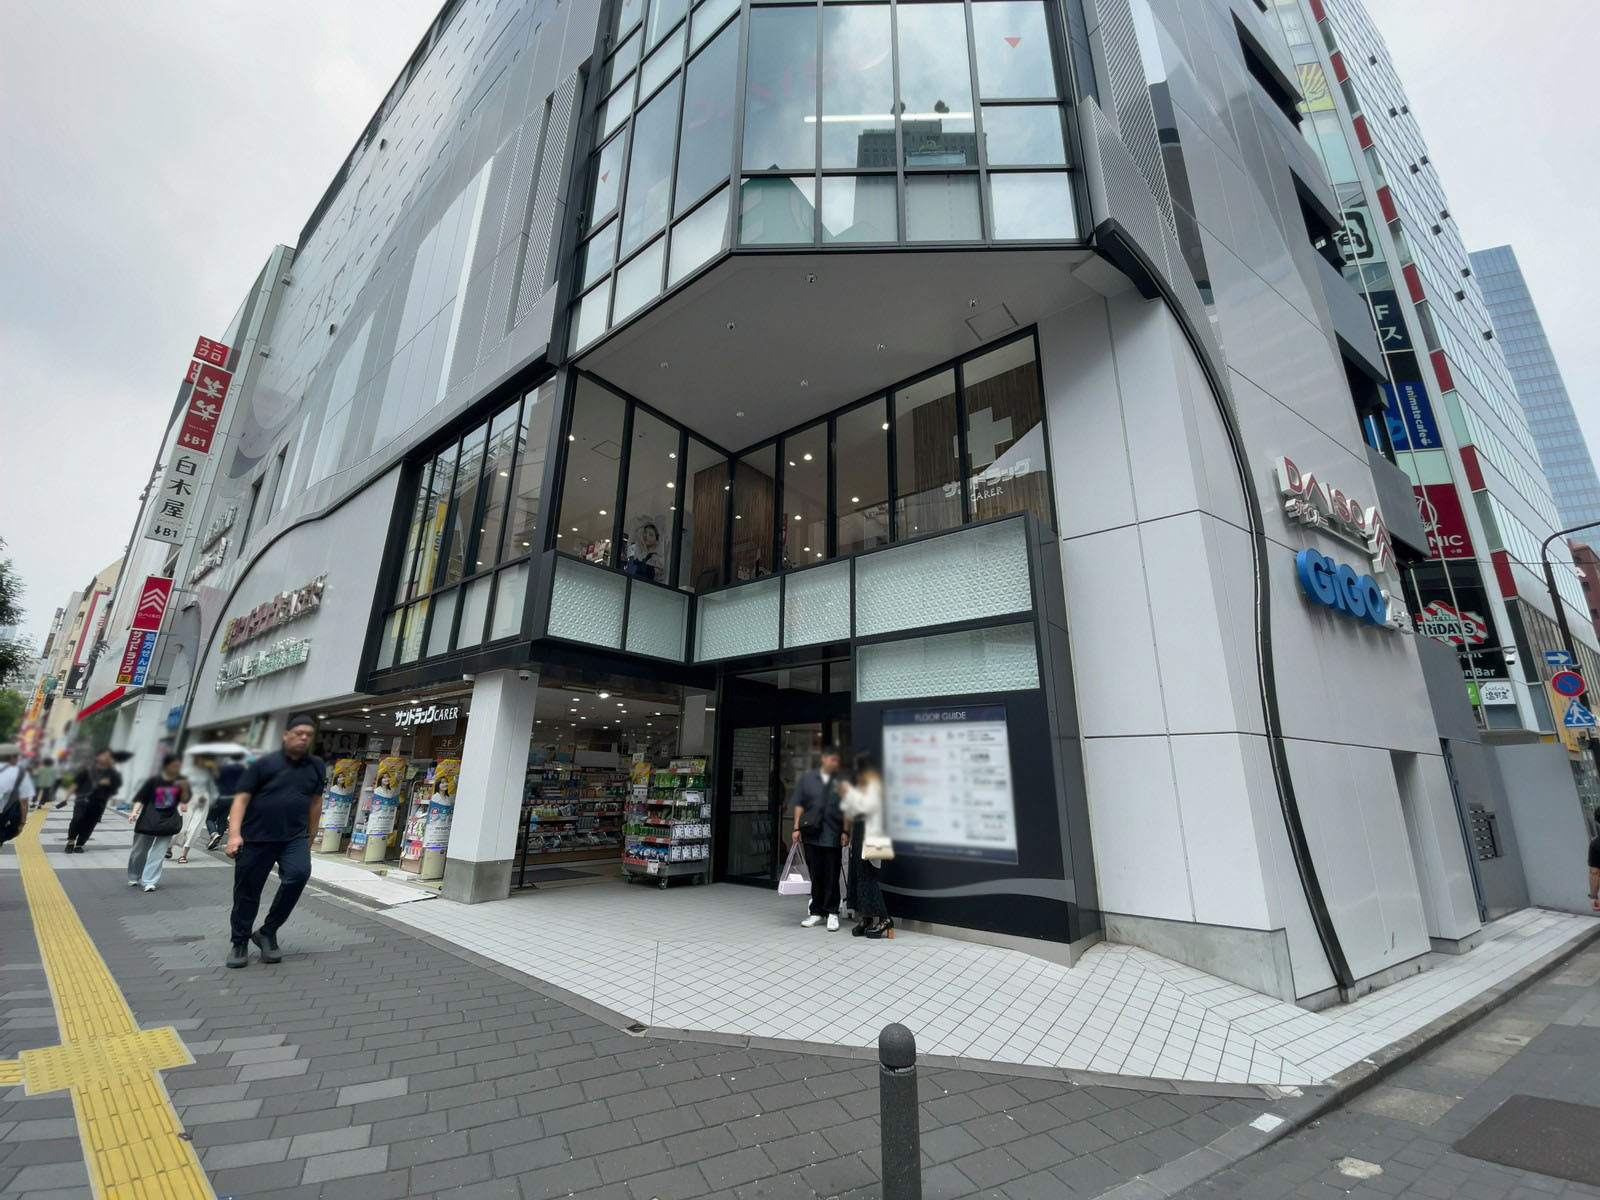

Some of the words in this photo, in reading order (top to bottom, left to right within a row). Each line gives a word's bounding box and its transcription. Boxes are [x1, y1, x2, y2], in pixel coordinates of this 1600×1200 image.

[192, 437, 206, 447] B1
[160, 456, 197, 519] 白木屋
[1277, 456, 1366, 532] DAISO
[163, 528, 178, 538] B1
[122, 631, 142, 674] サンドラッグ
[1476, 667, 1496, 677] Bar
[941, 711, 967, 721] GUIDE
